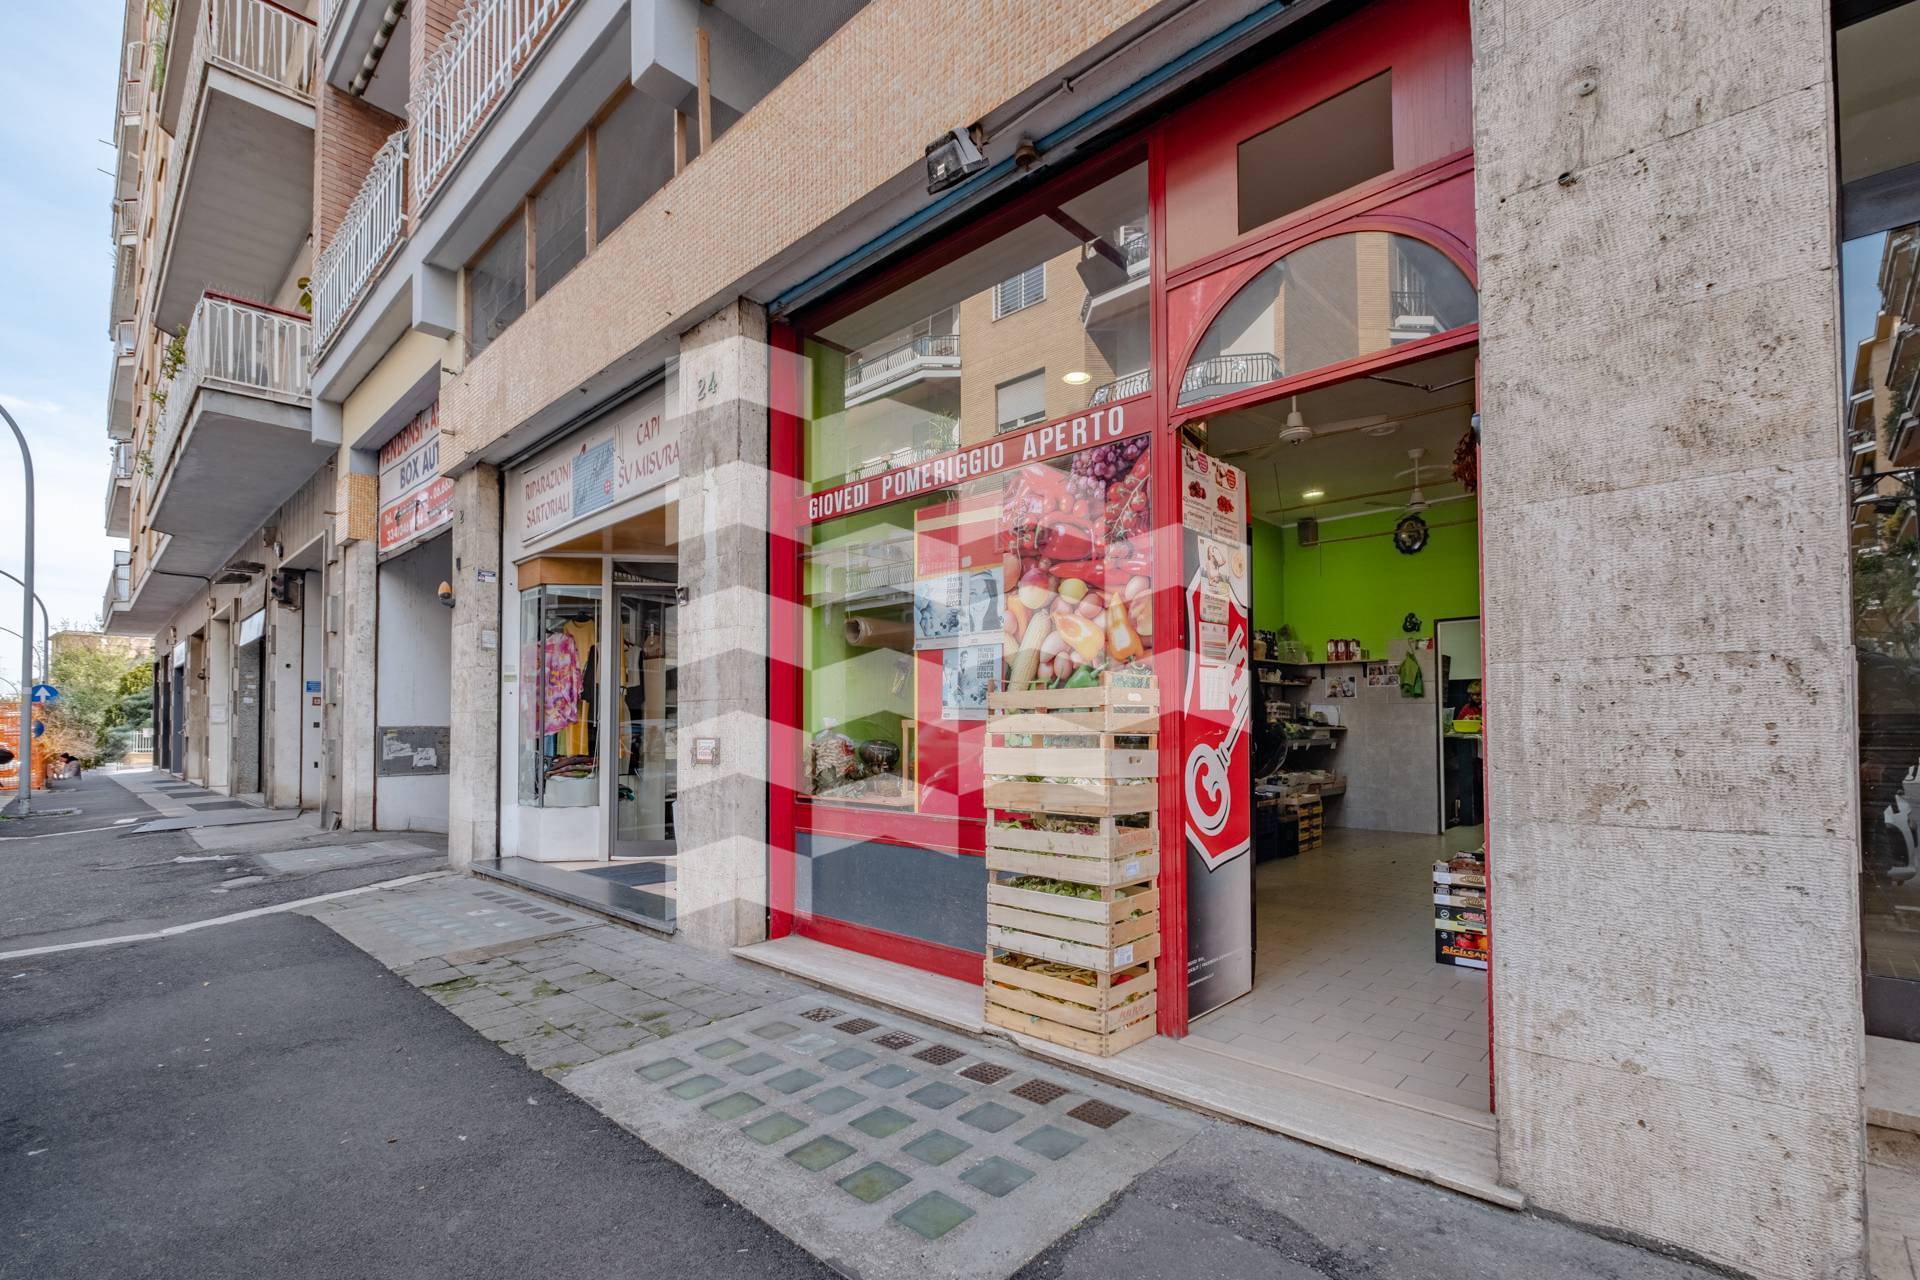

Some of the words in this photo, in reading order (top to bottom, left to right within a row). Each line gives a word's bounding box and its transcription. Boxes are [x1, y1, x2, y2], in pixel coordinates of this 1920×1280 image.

[697, 371, 718, 401] 24
[636, 415, 661, 446] CAPI
[400, 456, 419, 489] BOX
[808, 482, 869, 520] GIOVEDI
[882, 441, 1005, 499] POMERIGGIO
[1022, 405, 1125, 461] APERTO
[525, 462, 571, 501] RIPARAZIONI
[526, 493, 570, 528] SARTORIALI
